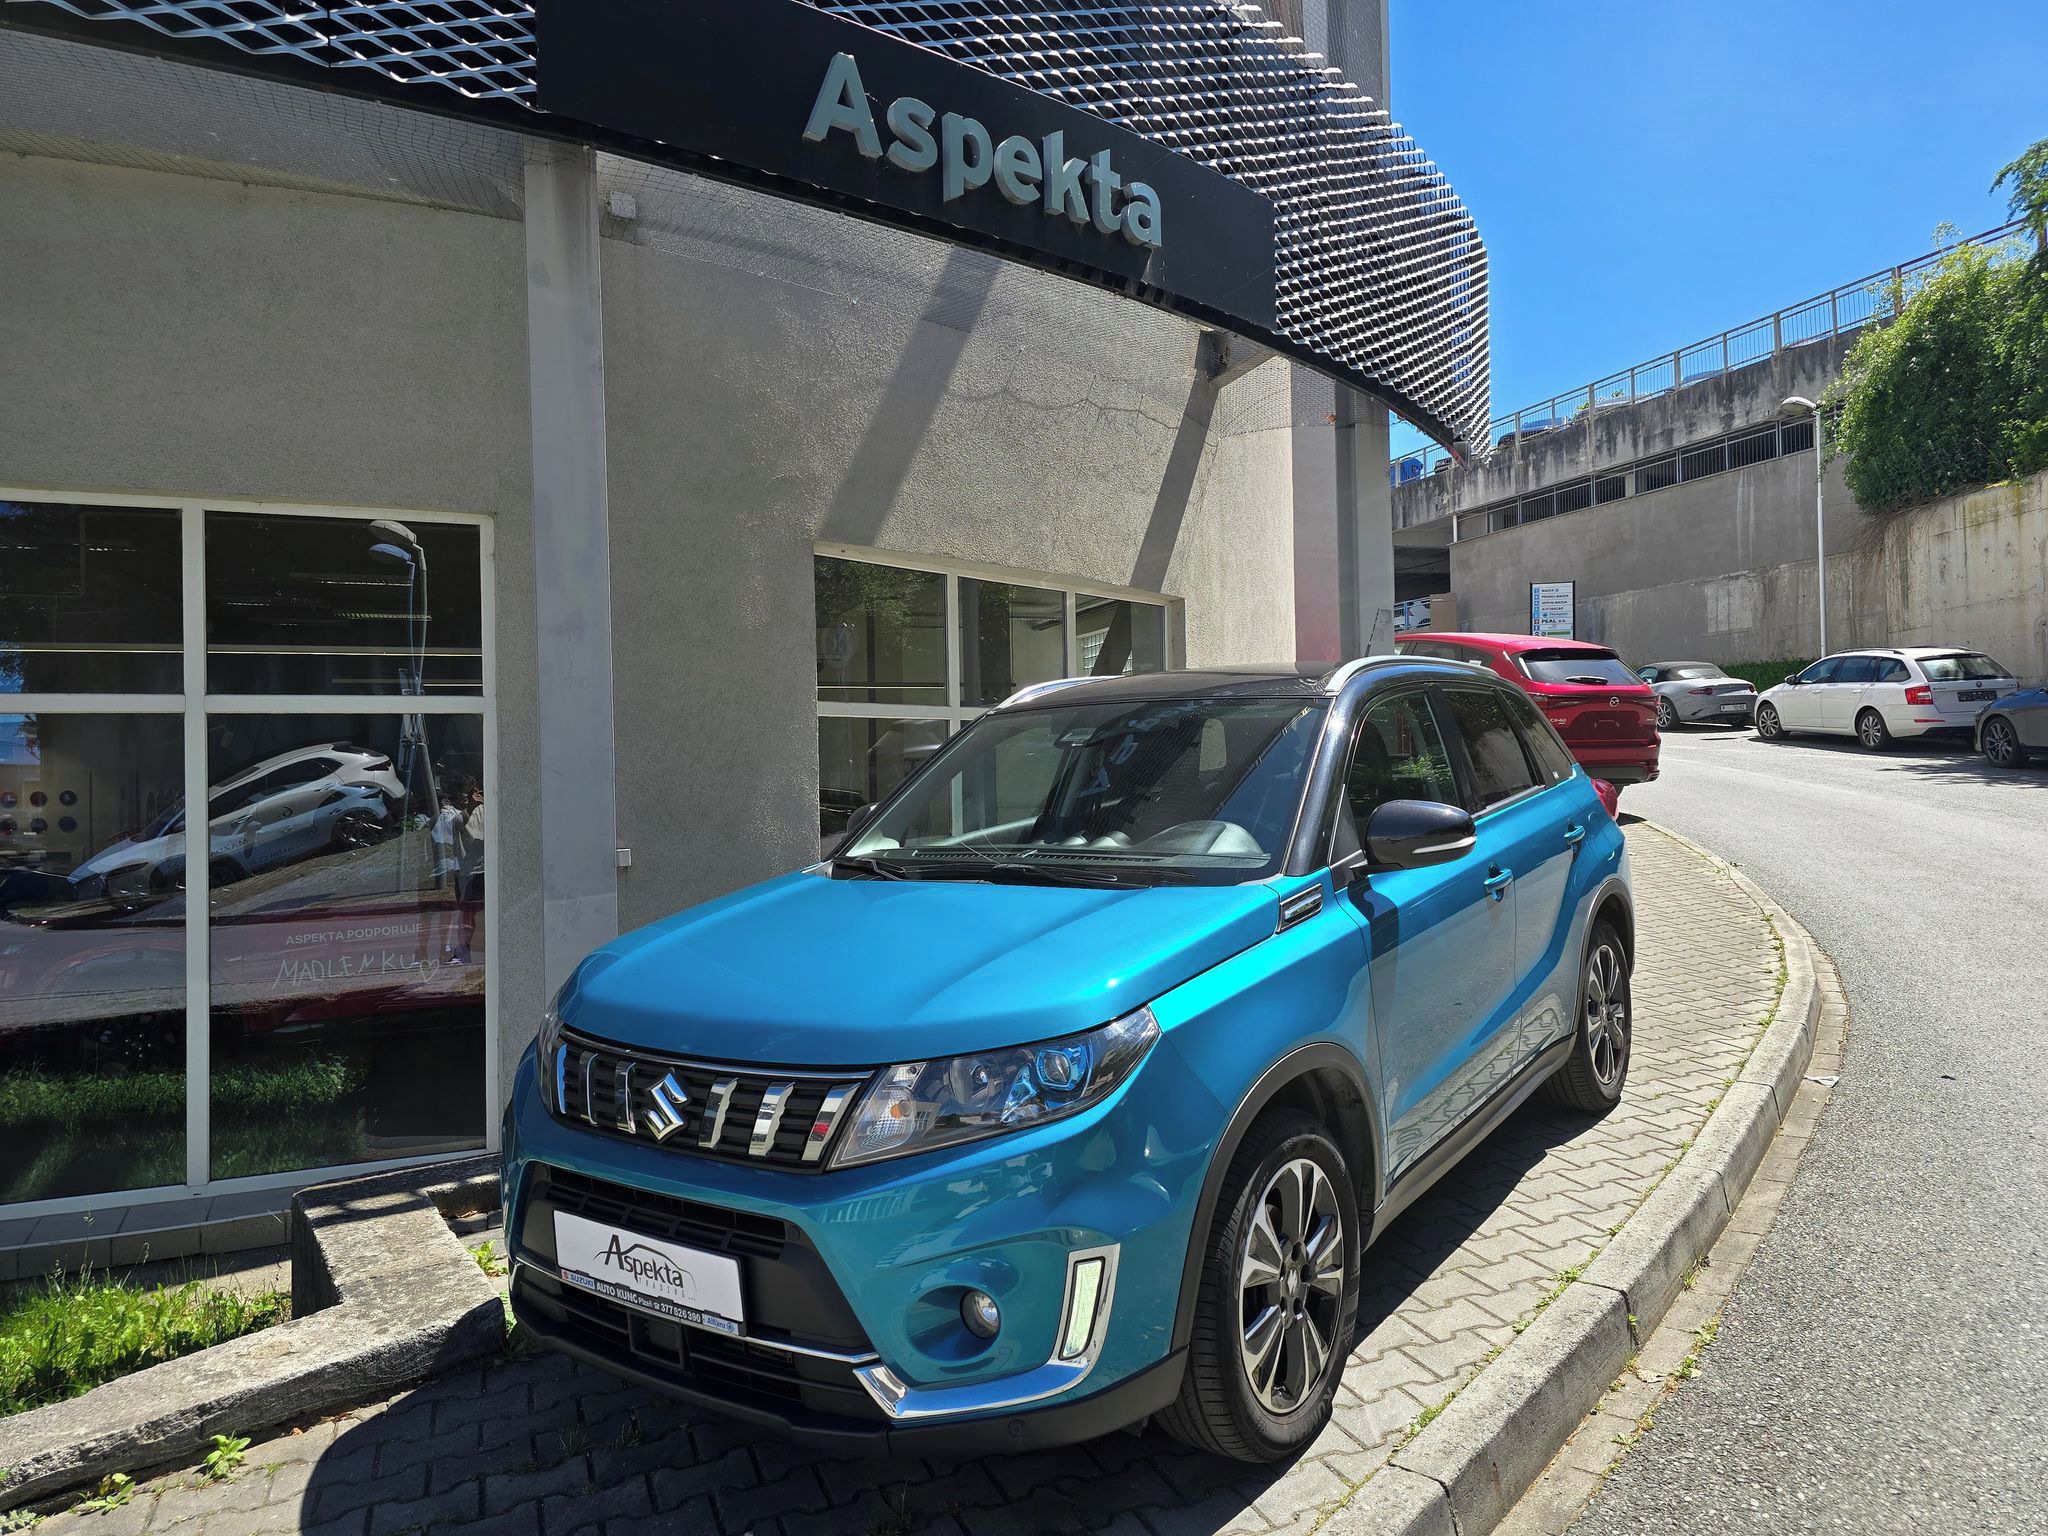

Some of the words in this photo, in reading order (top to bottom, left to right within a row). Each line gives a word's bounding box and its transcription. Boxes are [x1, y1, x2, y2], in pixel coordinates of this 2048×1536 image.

[802, 51, 1162, 250] Aspekta
[285, 930, 345, 945] ASPEKTA
[346, 923, 423, 940] PODPORUJE
[604, 1234, 684, 1288] Aspekta
[570, 1273, 595, 1288] SUZUKI
[596, 1282, 616, 1296] AUTO
[616, 1287, 639, 1304] KUNC
[660, 1303, 673, 1315] 377
